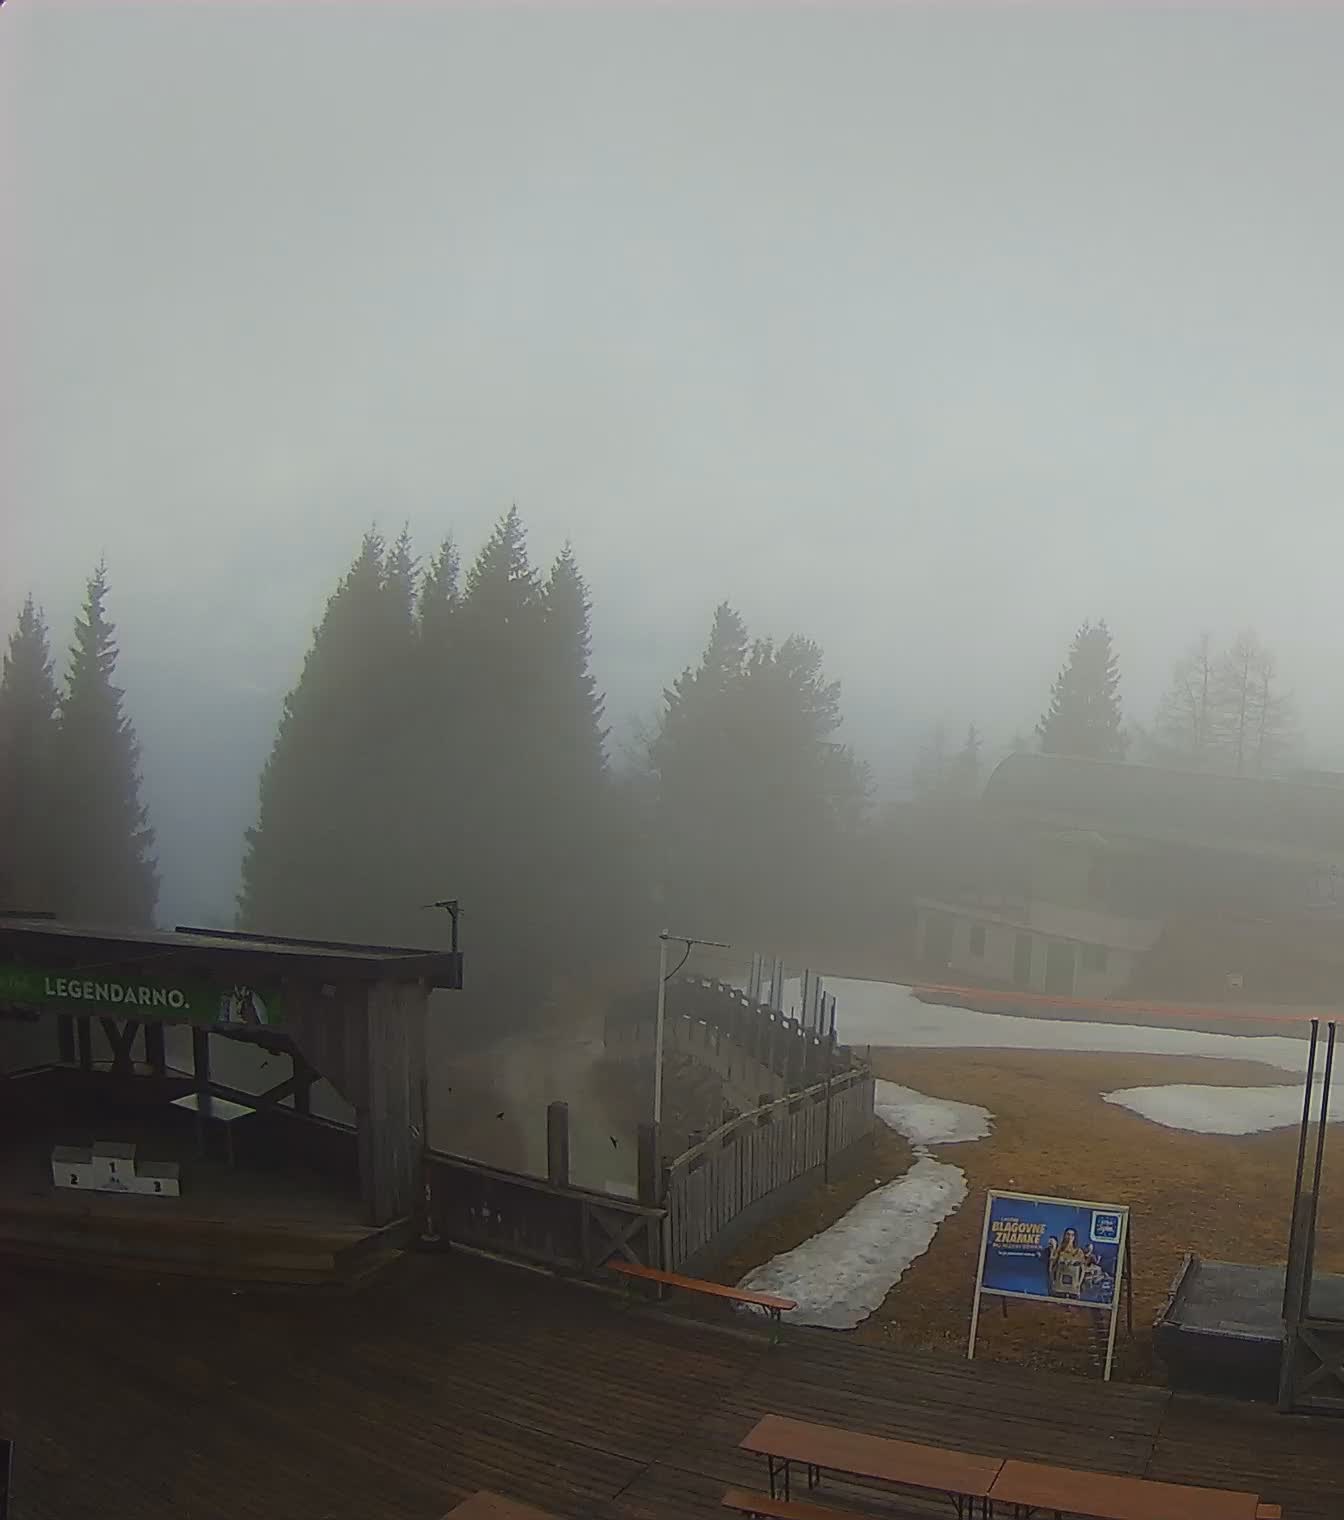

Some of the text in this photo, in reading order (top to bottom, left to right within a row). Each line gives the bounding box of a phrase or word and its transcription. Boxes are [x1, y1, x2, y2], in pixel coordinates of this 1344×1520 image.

[44, 976, 190, 1009] LEGENDARNO.
[109, 1161, 116, 1173] 1
[70, 1174, 78, 1185] 2
[153, 1181, 161, 1192] 3
[992, 1221, 1047, 1234] BLAGOVNE
[995, 1232, 1041, 1244] ZNAMKE
